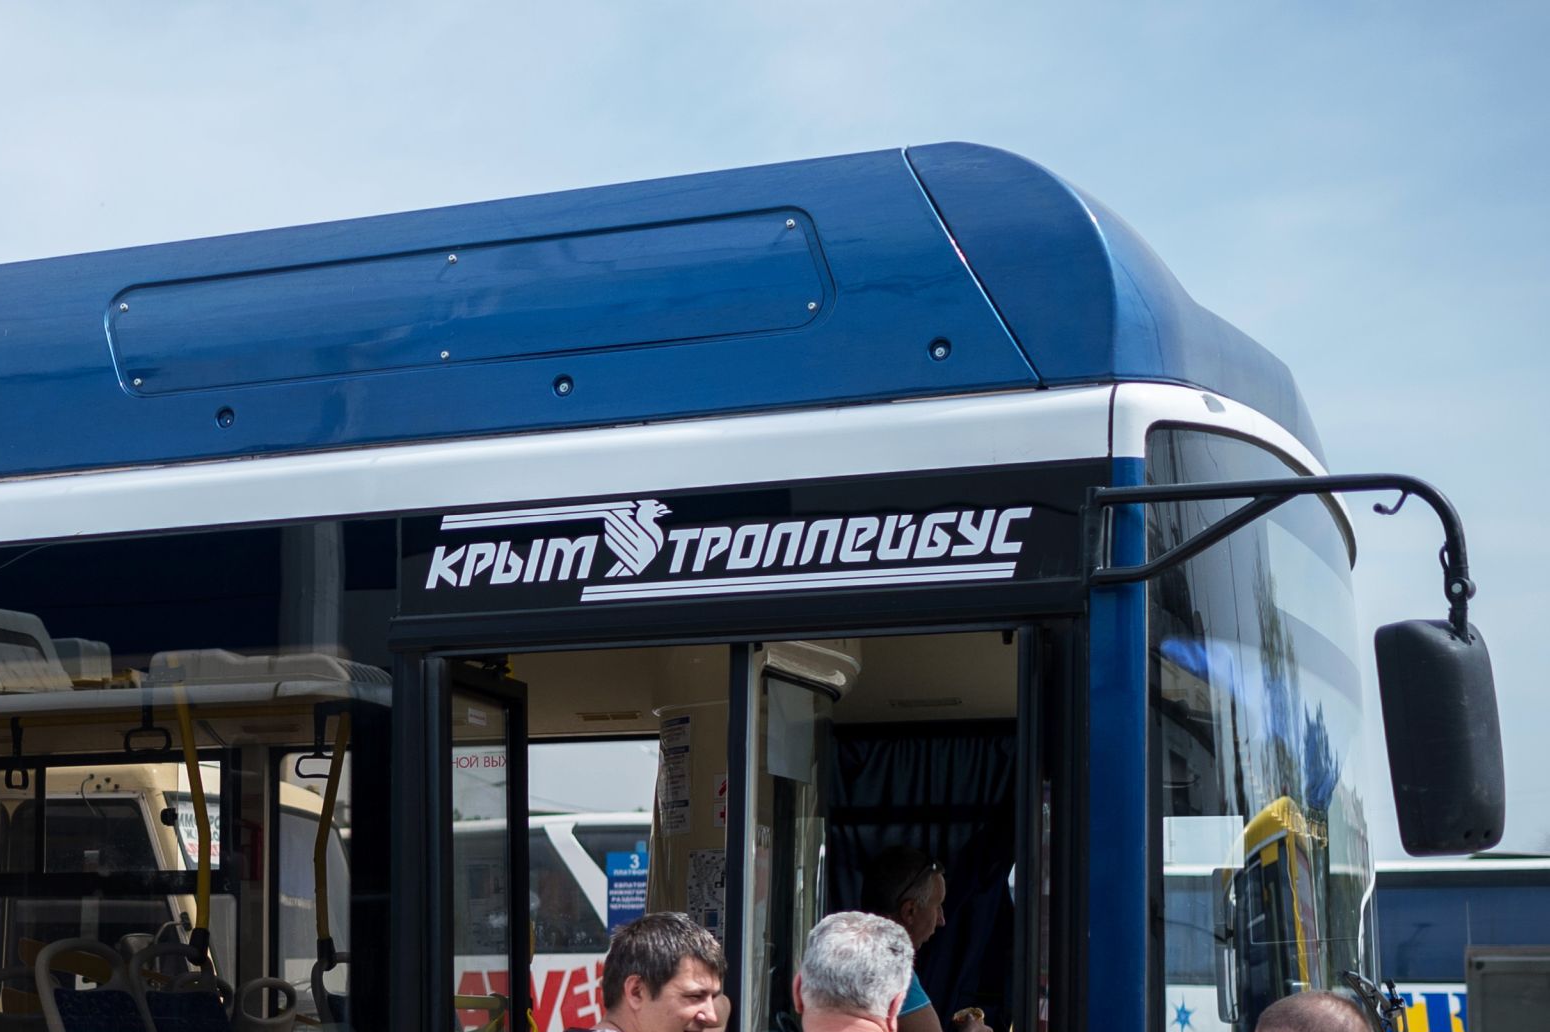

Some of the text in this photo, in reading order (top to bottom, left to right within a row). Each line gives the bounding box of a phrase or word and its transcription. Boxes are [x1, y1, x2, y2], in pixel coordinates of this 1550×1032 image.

[425, 507, 1032, 589] КРЫМ ТРОЛЛЕЙБУС
[630, 854, 640, 869] 3
